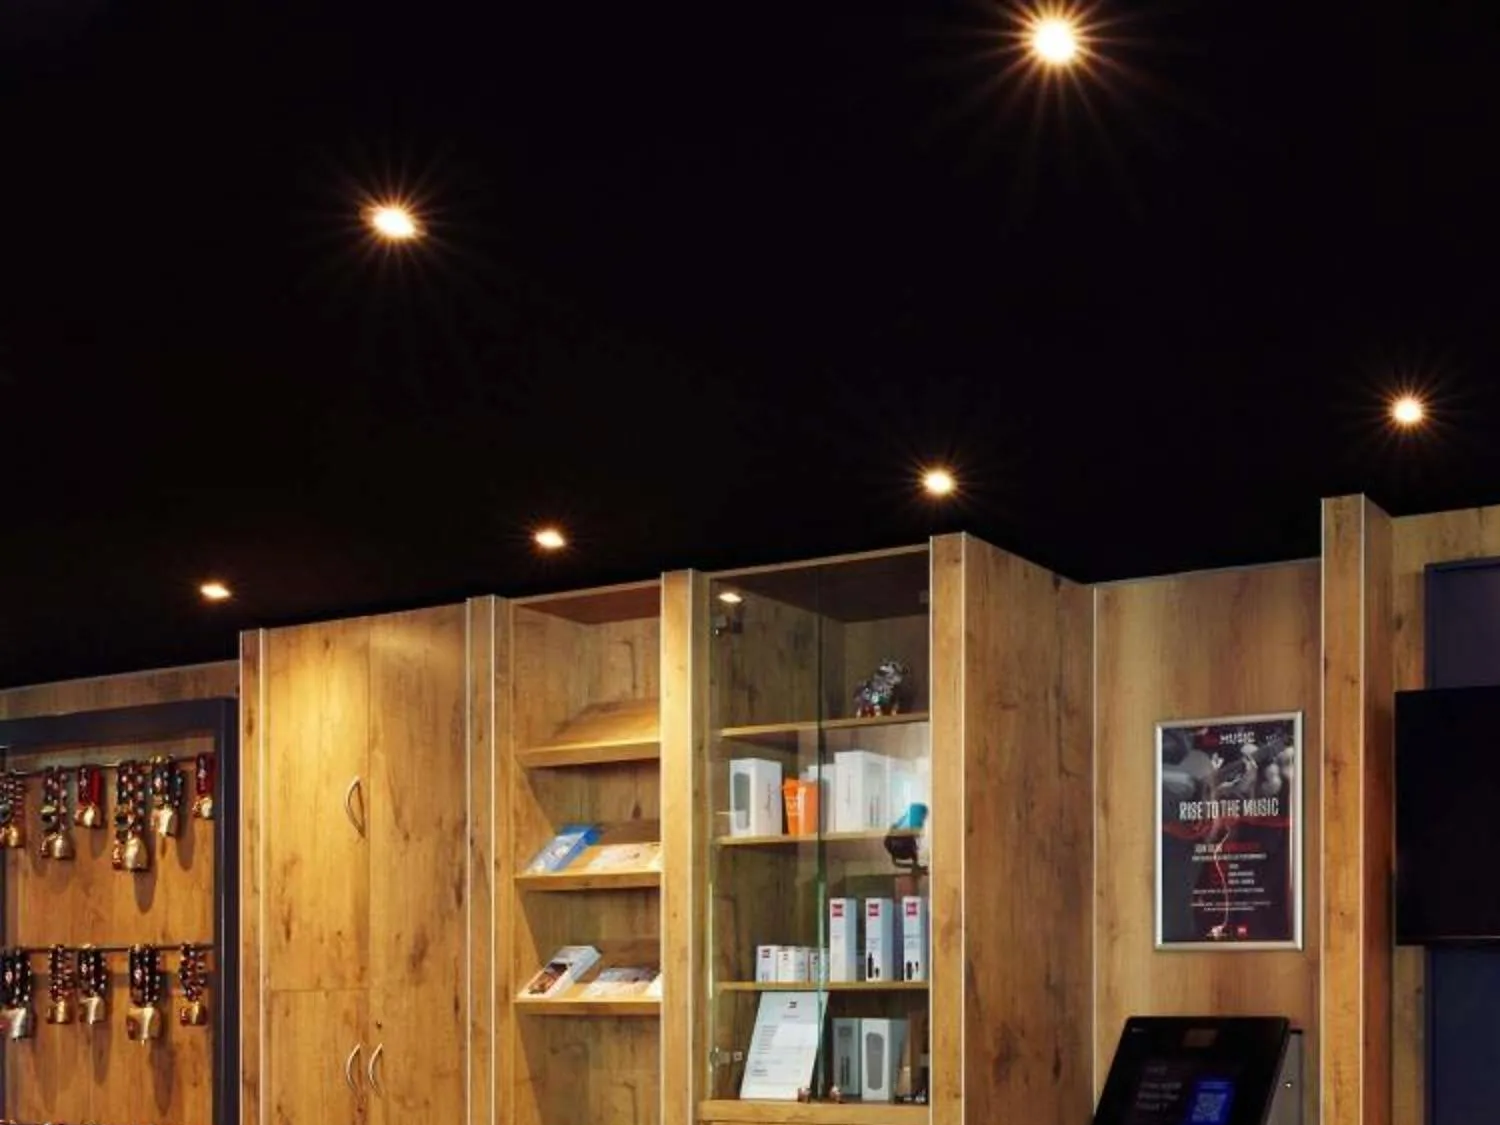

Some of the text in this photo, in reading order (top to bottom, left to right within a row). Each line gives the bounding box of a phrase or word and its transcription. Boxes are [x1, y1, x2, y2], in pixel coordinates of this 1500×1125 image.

[1180, 798, 1279, 820] RISE TO THE MUSIC
